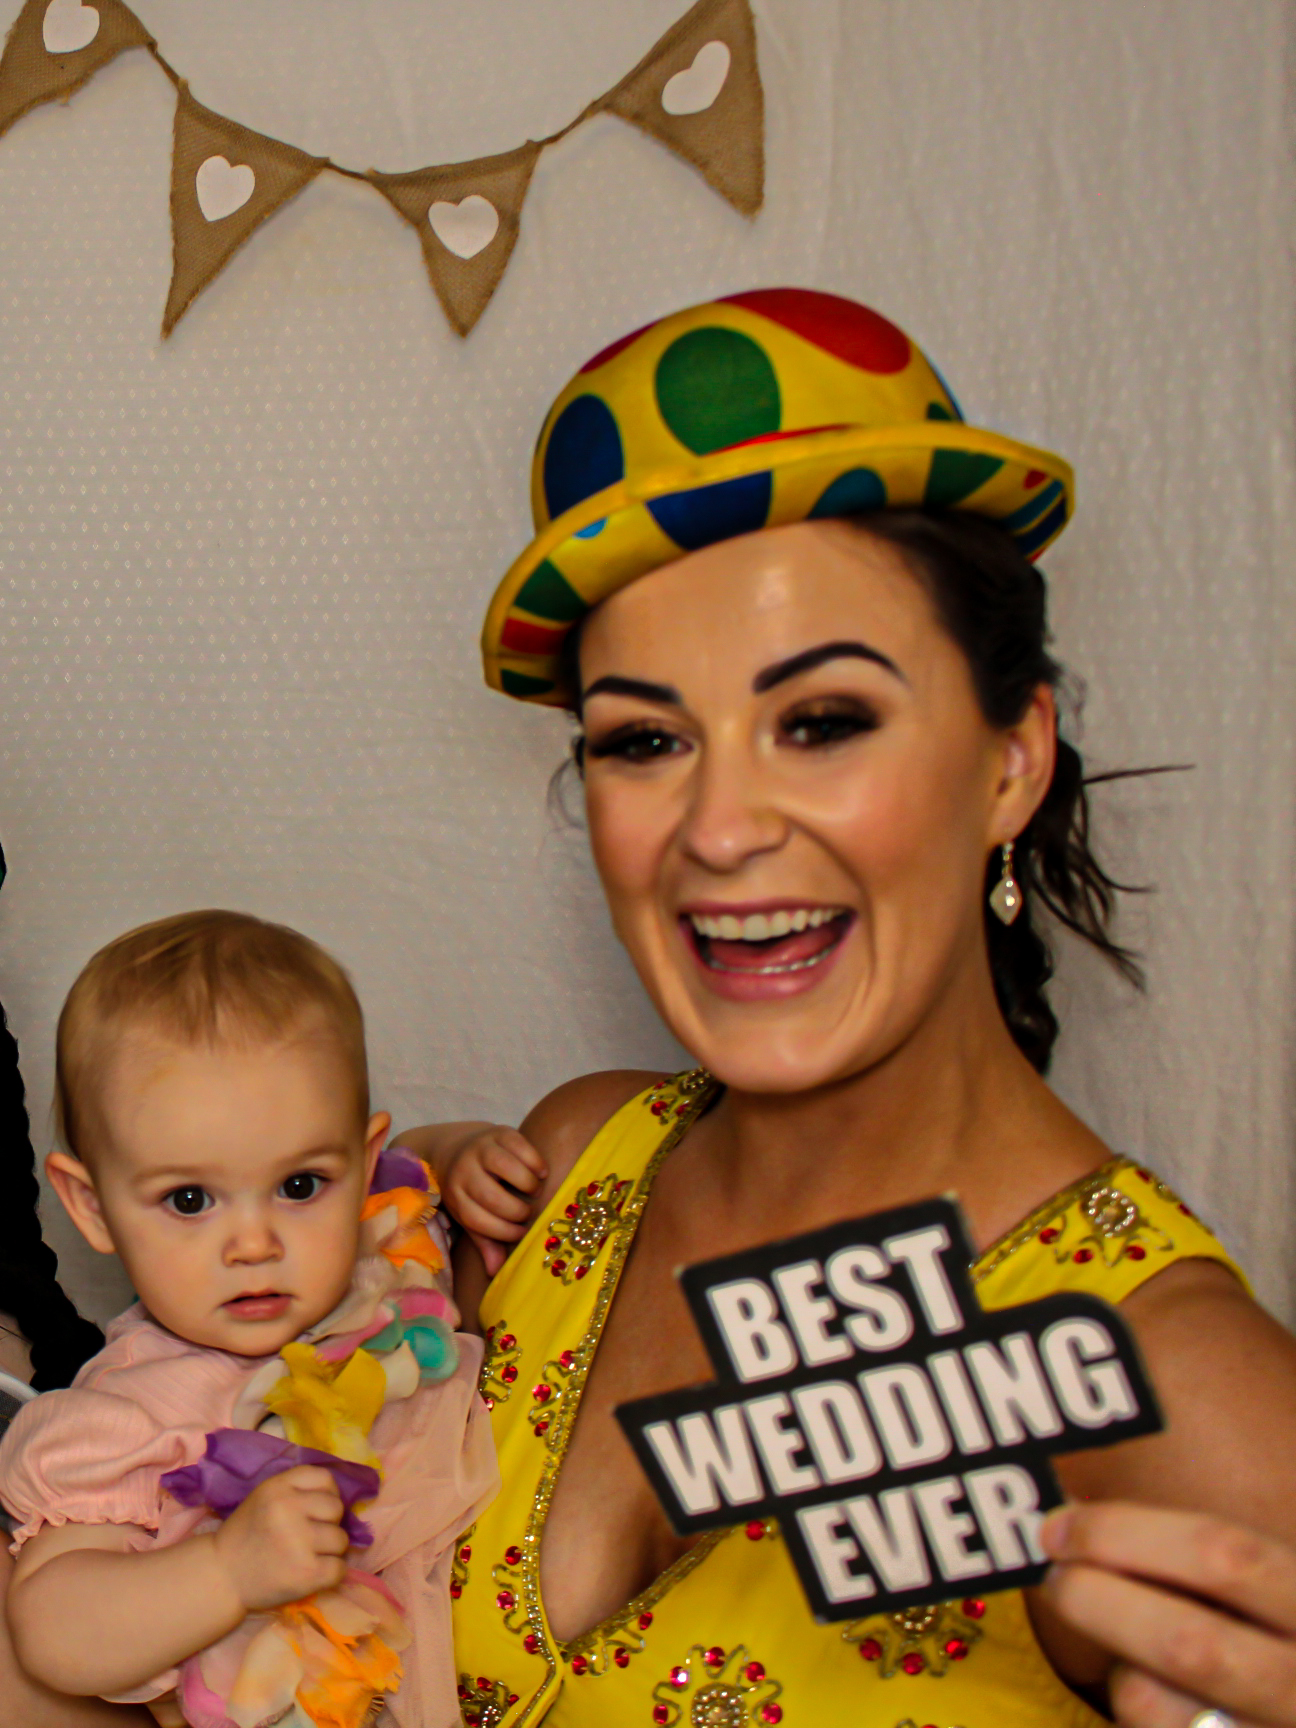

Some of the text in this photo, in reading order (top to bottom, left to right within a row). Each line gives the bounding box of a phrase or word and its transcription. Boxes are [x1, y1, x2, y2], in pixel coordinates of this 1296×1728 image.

[706, 1224, 964, 1383] BEST
[642, 1316, 1139, 1516] WEDDING
[795, 1463, 1048, 1604] EVER
